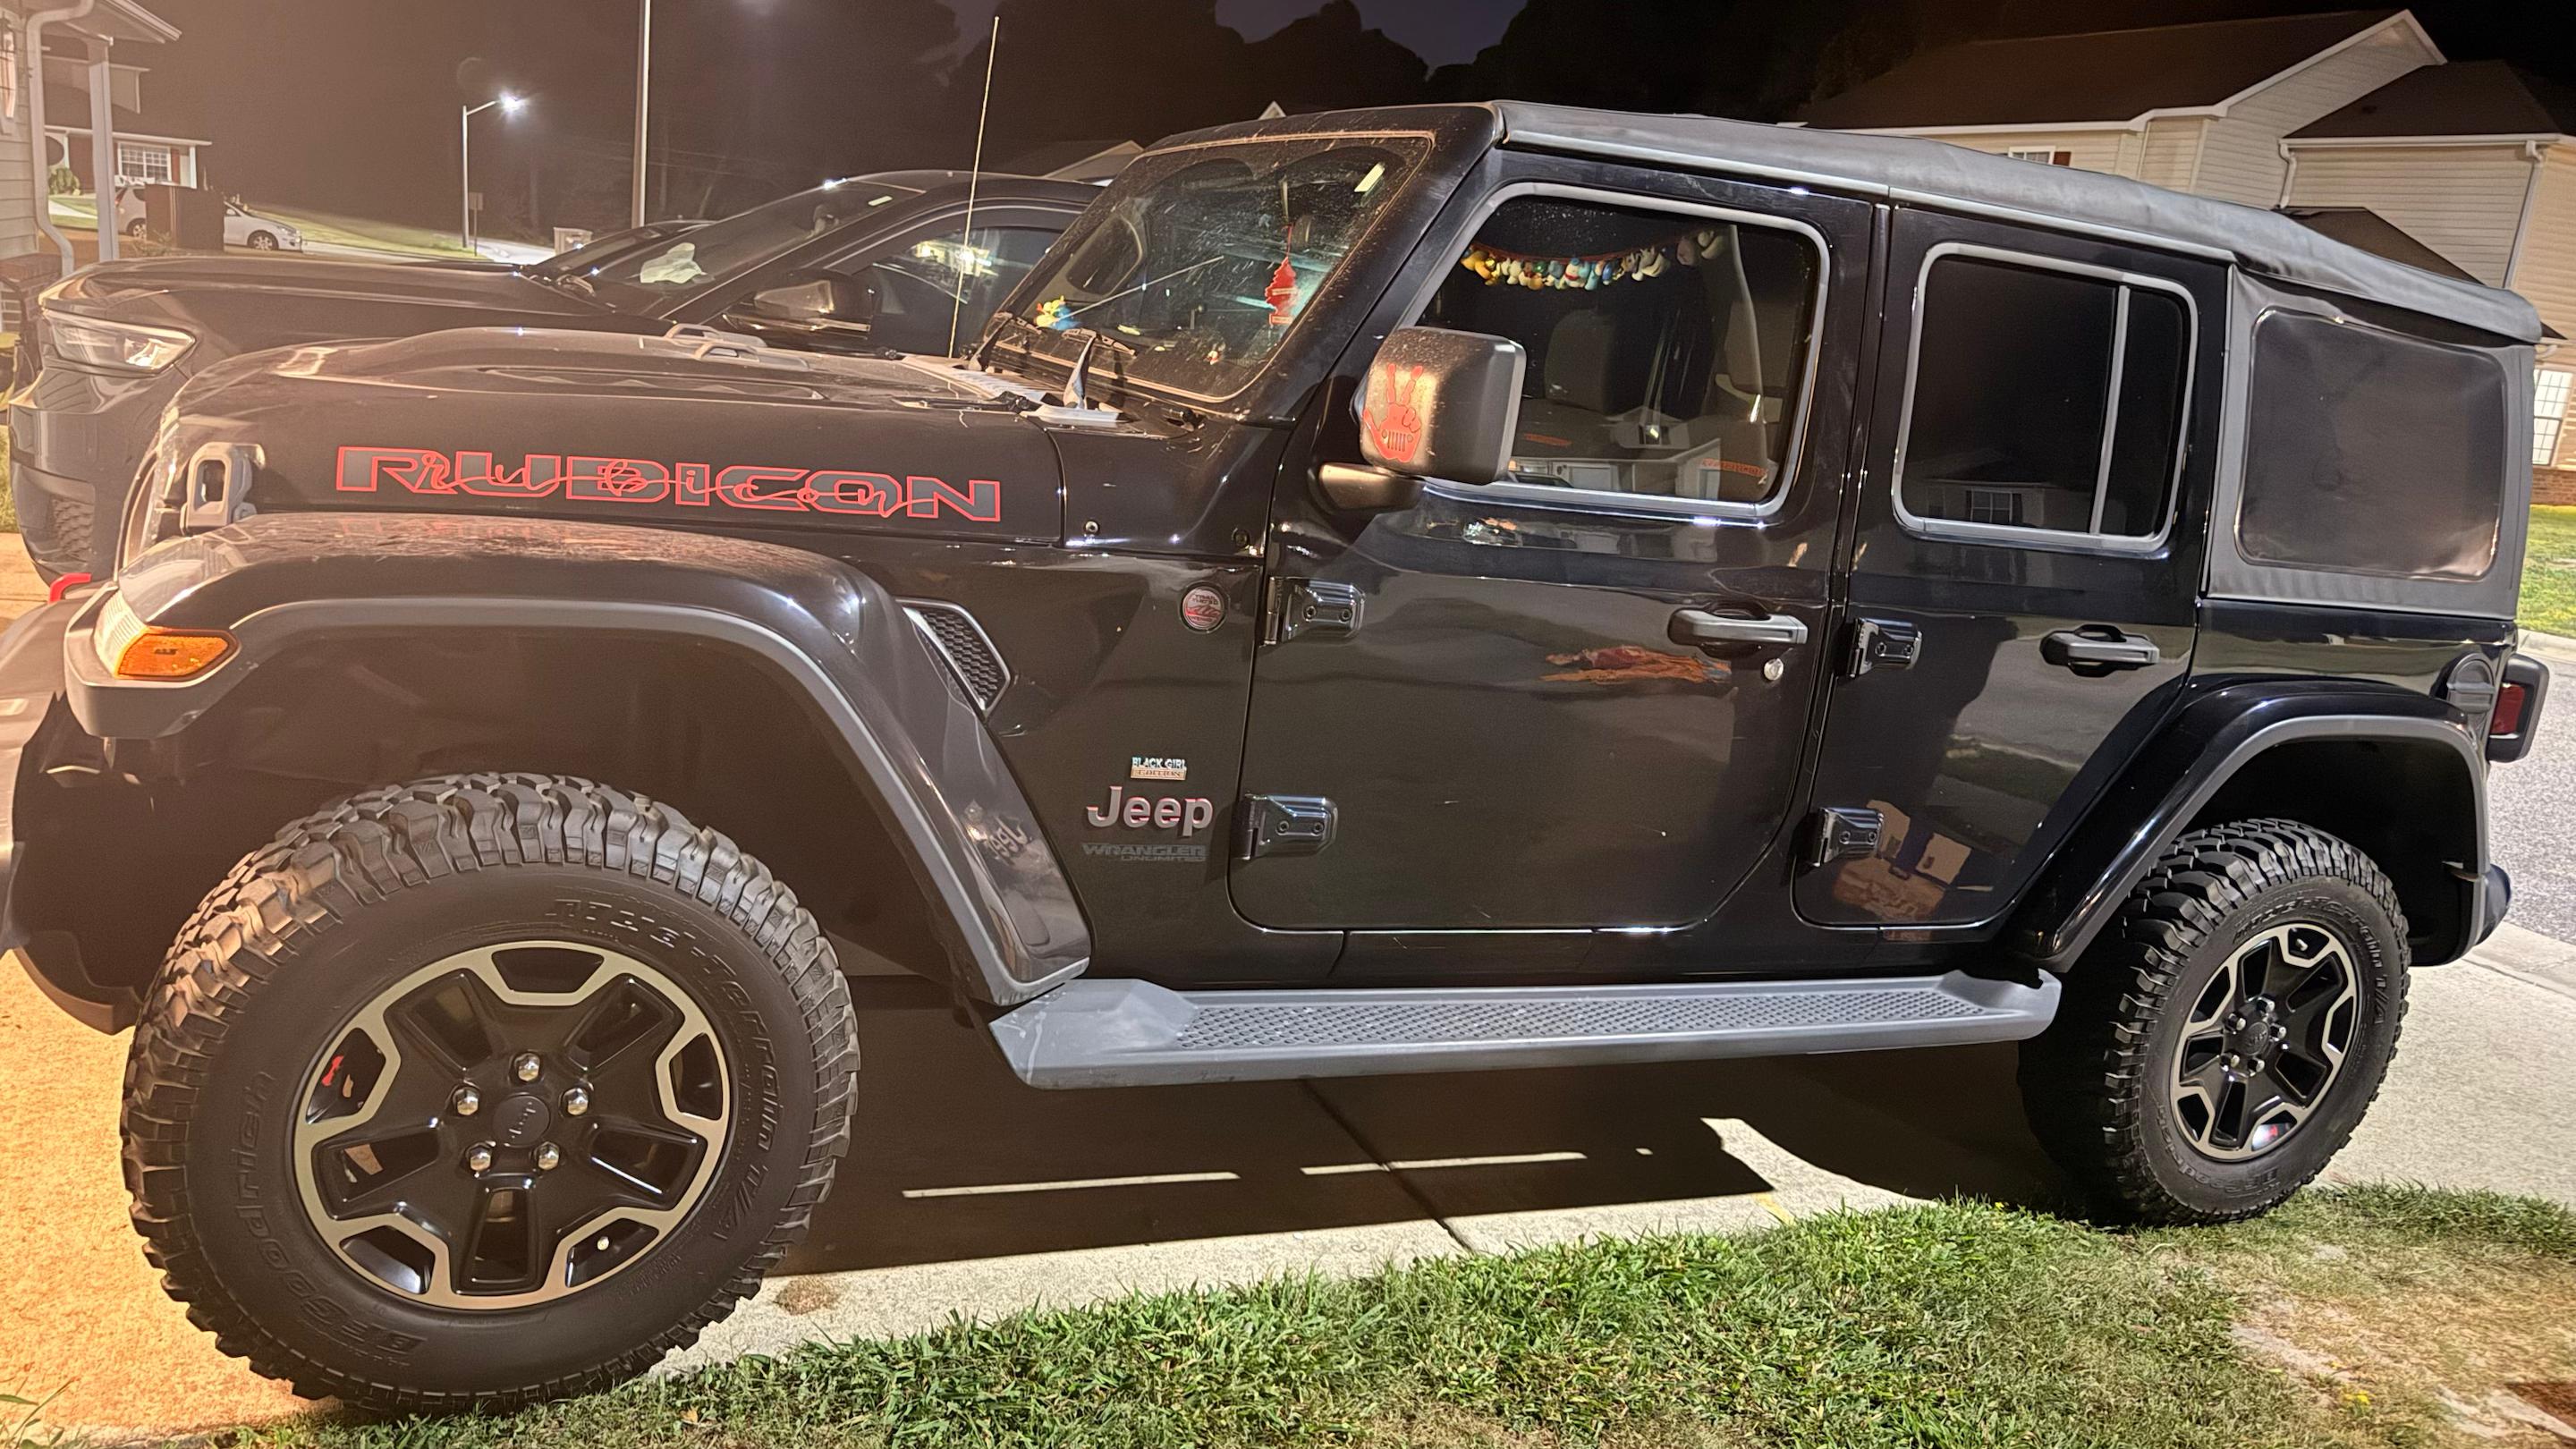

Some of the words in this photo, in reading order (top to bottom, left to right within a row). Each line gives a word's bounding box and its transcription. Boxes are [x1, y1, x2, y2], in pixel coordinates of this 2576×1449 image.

[336, 445, 1000, 521] RUBICON
[1131, 757, 1164, 768] BLACK
[1165, 758, 1187, 770] GIRL
[1086, 786, 1213, 836] Jeep
[1081, 843, 1207, 856] WRANGLER
